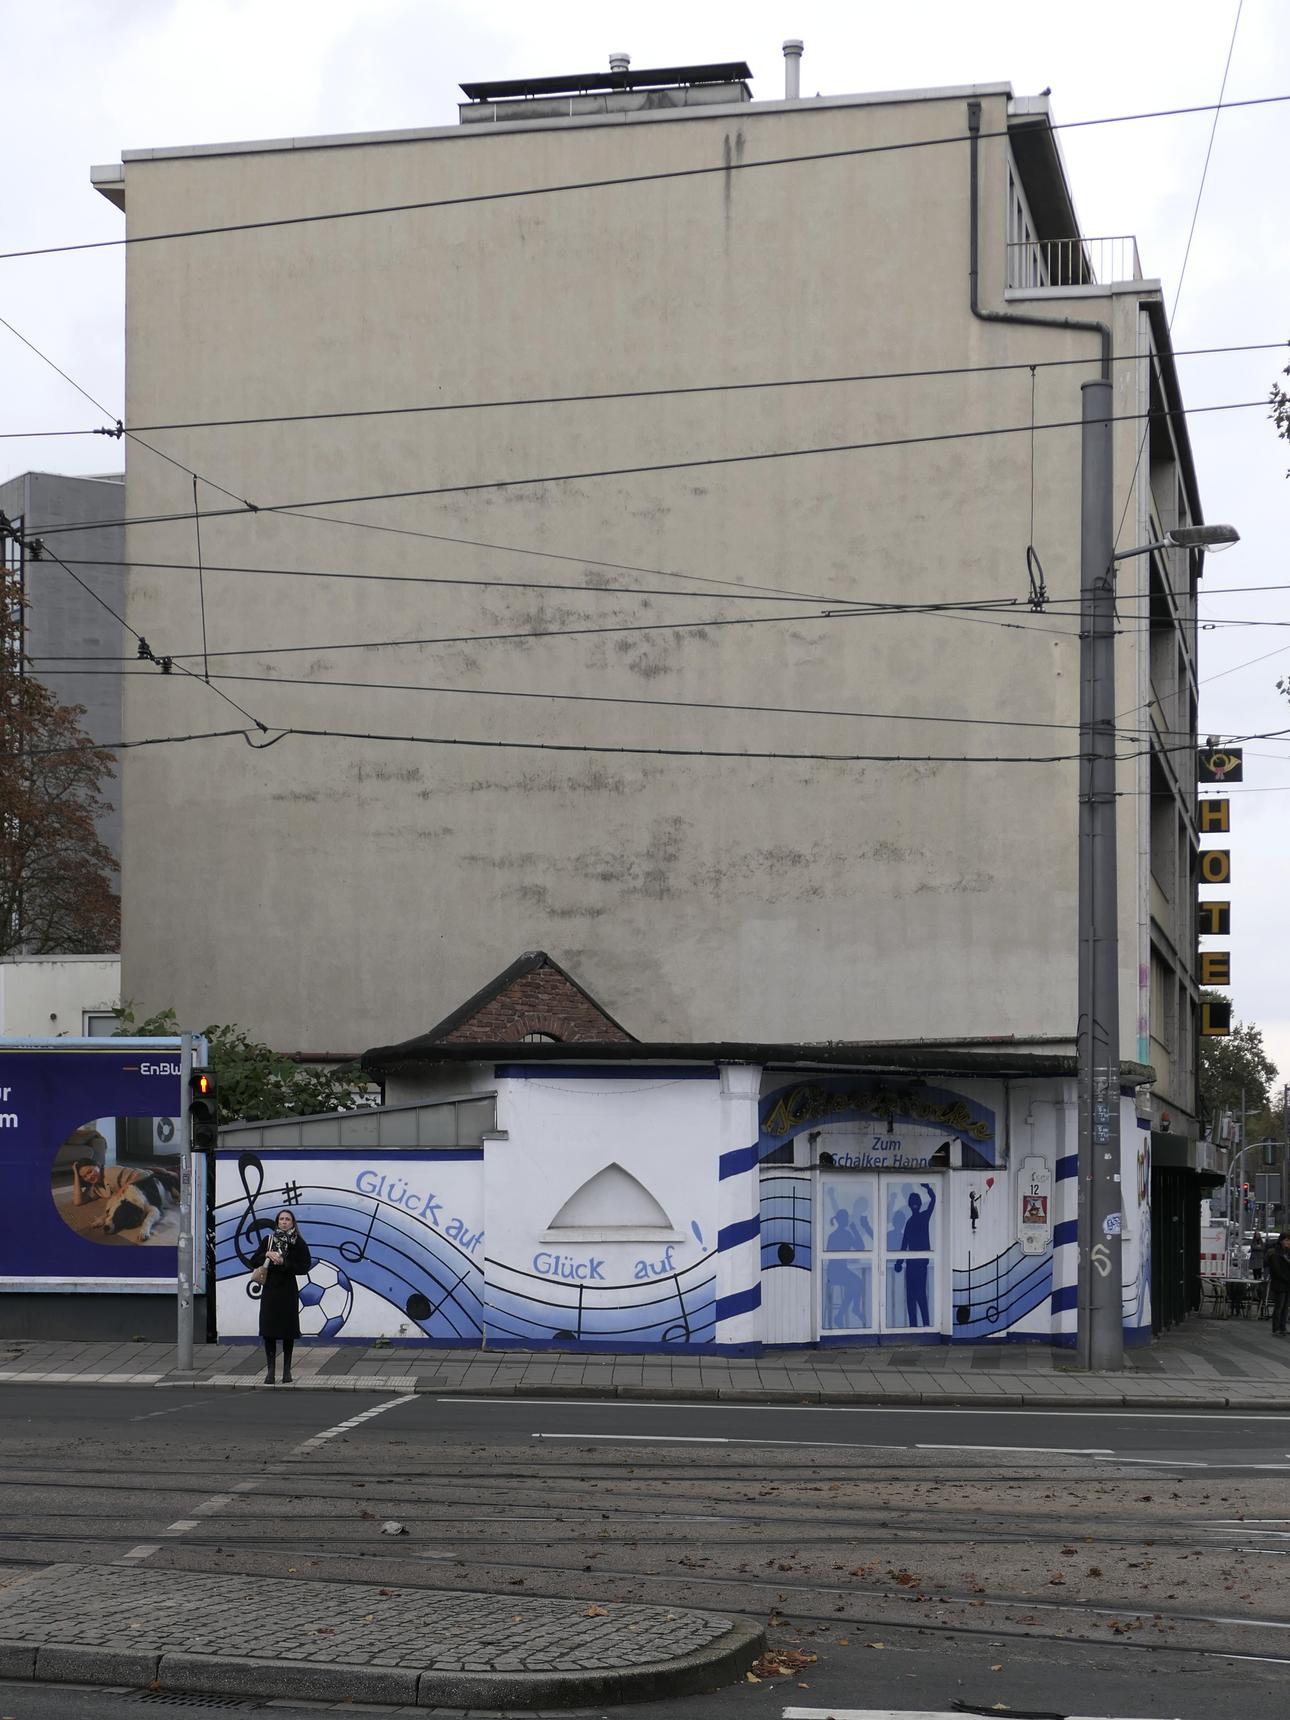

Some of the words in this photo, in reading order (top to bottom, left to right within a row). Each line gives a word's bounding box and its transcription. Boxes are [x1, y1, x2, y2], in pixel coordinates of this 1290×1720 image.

[1202, 799, 1229, 1034] HOTEL
[140, 1062, 182, 1075] EnBW
[871, 1136, 901, 1151] Zum
[831, 1151, 888, 1168] Schalker
[1030, 1184, 1040, 1195] 12
[355, 1169, 443, 1227] Glück
[444, 1217, 485, 1254] auf
[533, 1252, 605, 1280] Glück
[634, 1245, 676, 1280] auf
